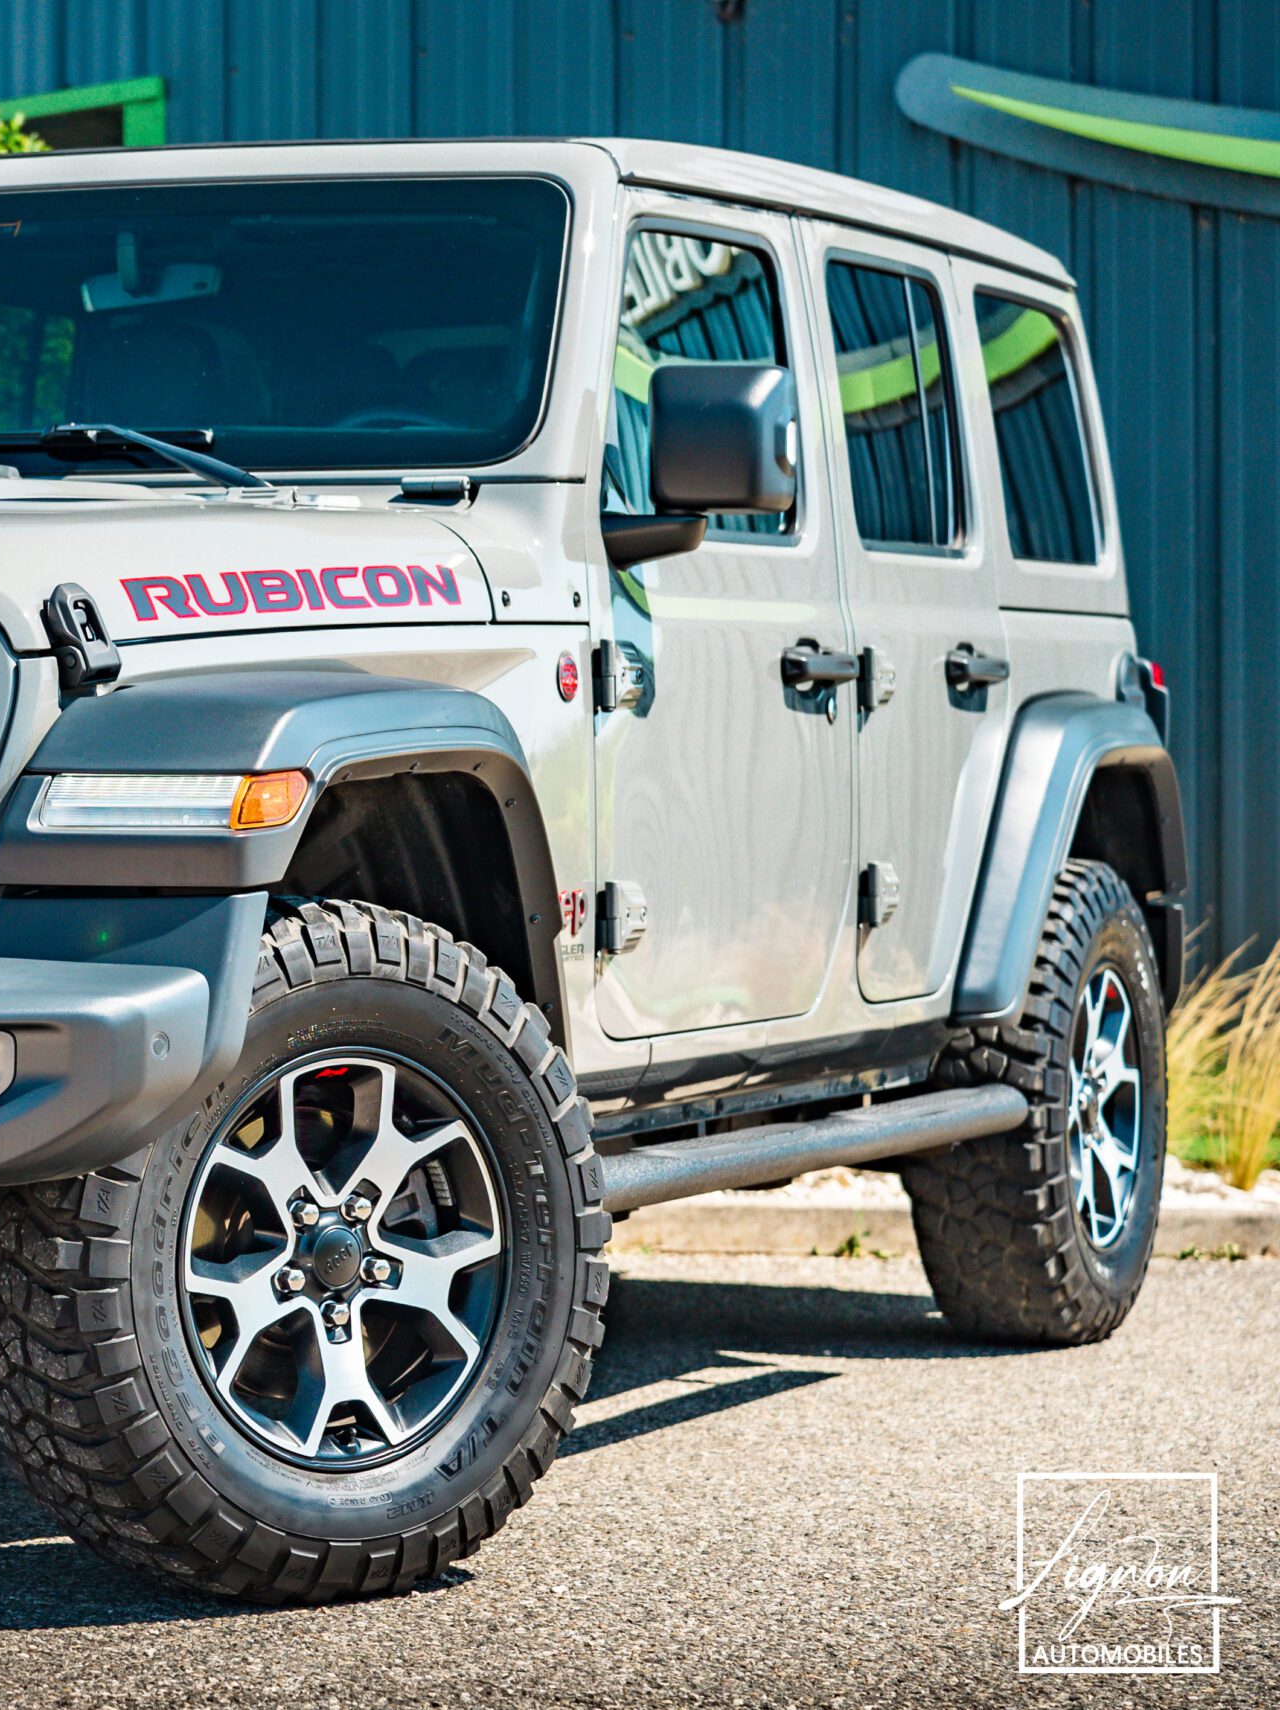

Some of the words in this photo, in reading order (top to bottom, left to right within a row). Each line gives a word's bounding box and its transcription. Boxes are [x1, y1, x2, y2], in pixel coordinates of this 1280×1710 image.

[119, 565, 462, 621] RUBICON
[433, 1022, 555, 1398] Mud-Terrain
[324, 1239, 354, 1275] Jeep
[433, 1410, 505, 1482] T/A
[339, 1496, 367, 1507] RANGE
[369, 1492, 391, 1504] LOAD
[386, 1490, 436, 1521] KM2
